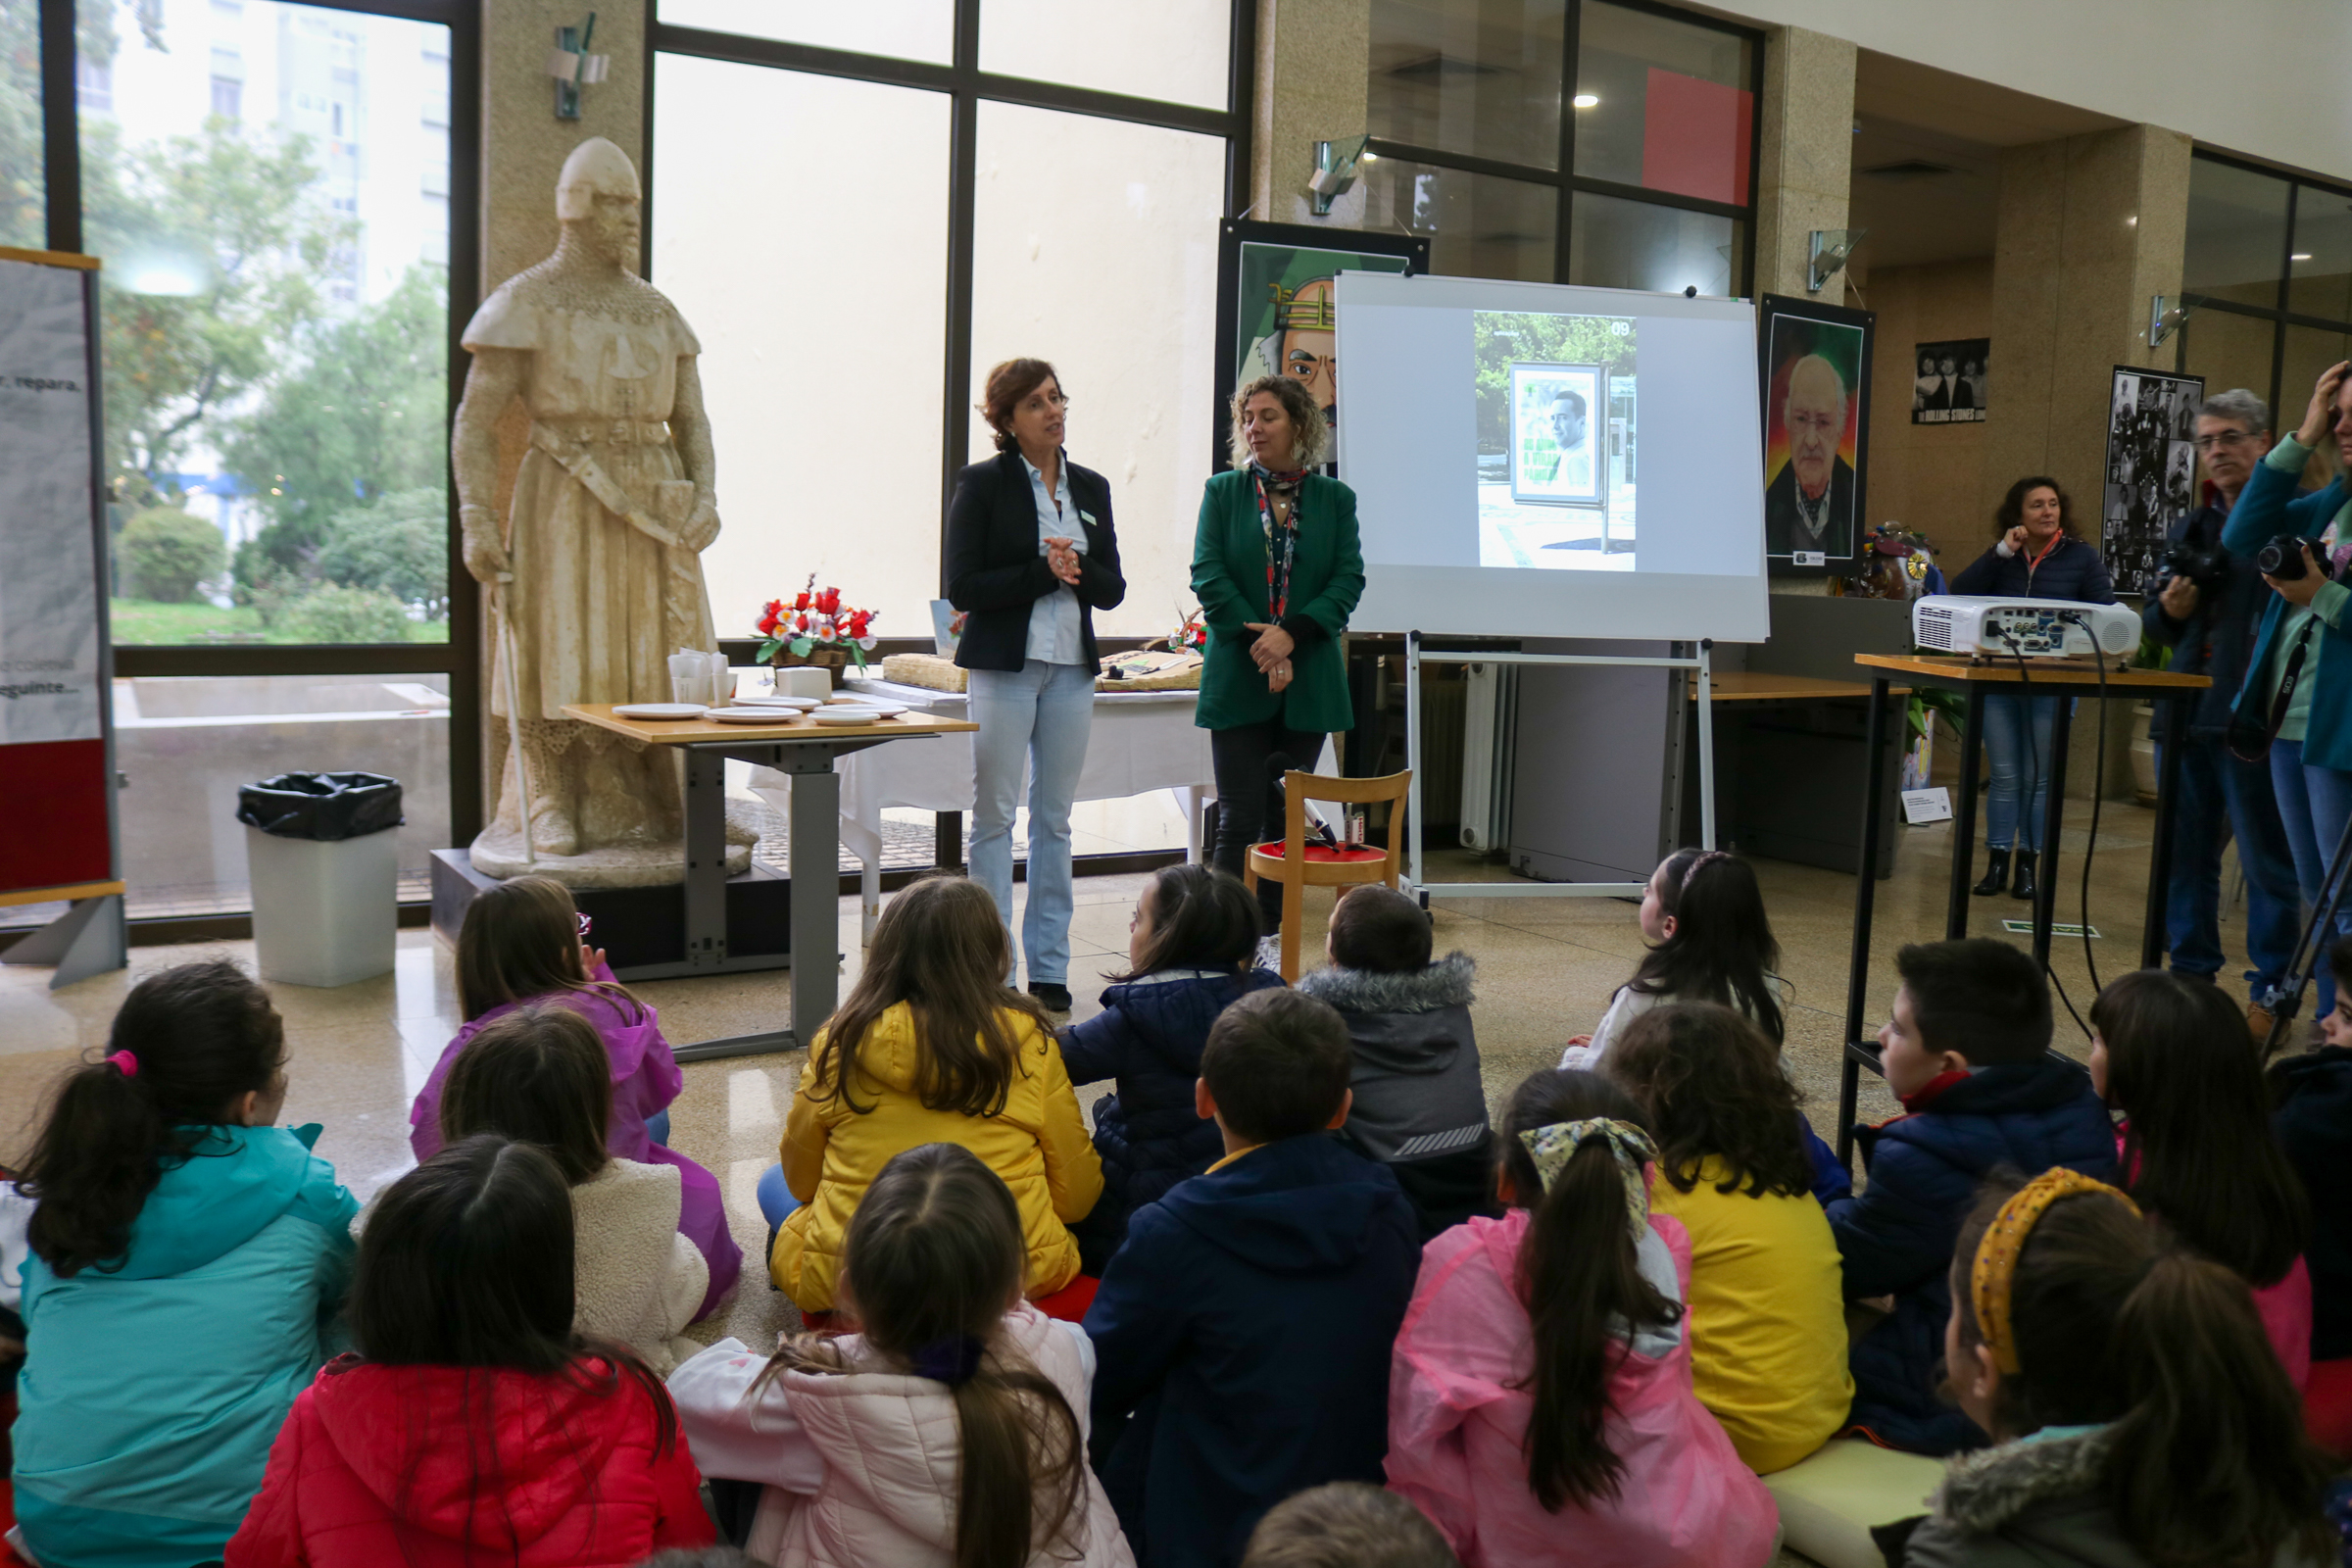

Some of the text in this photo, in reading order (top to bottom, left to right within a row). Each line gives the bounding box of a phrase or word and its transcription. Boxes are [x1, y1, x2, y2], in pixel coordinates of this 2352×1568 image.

[1610, 321, 1631, 336] 09
[15, 376, 81, 393] repara.
[1925, 410, 1950, 422] ROLLING
[1950, 408, 1975, 421] STONES
[1533, 452, 1558, 466] VIRAR
[2282, 675, 2294, 694] EOS
